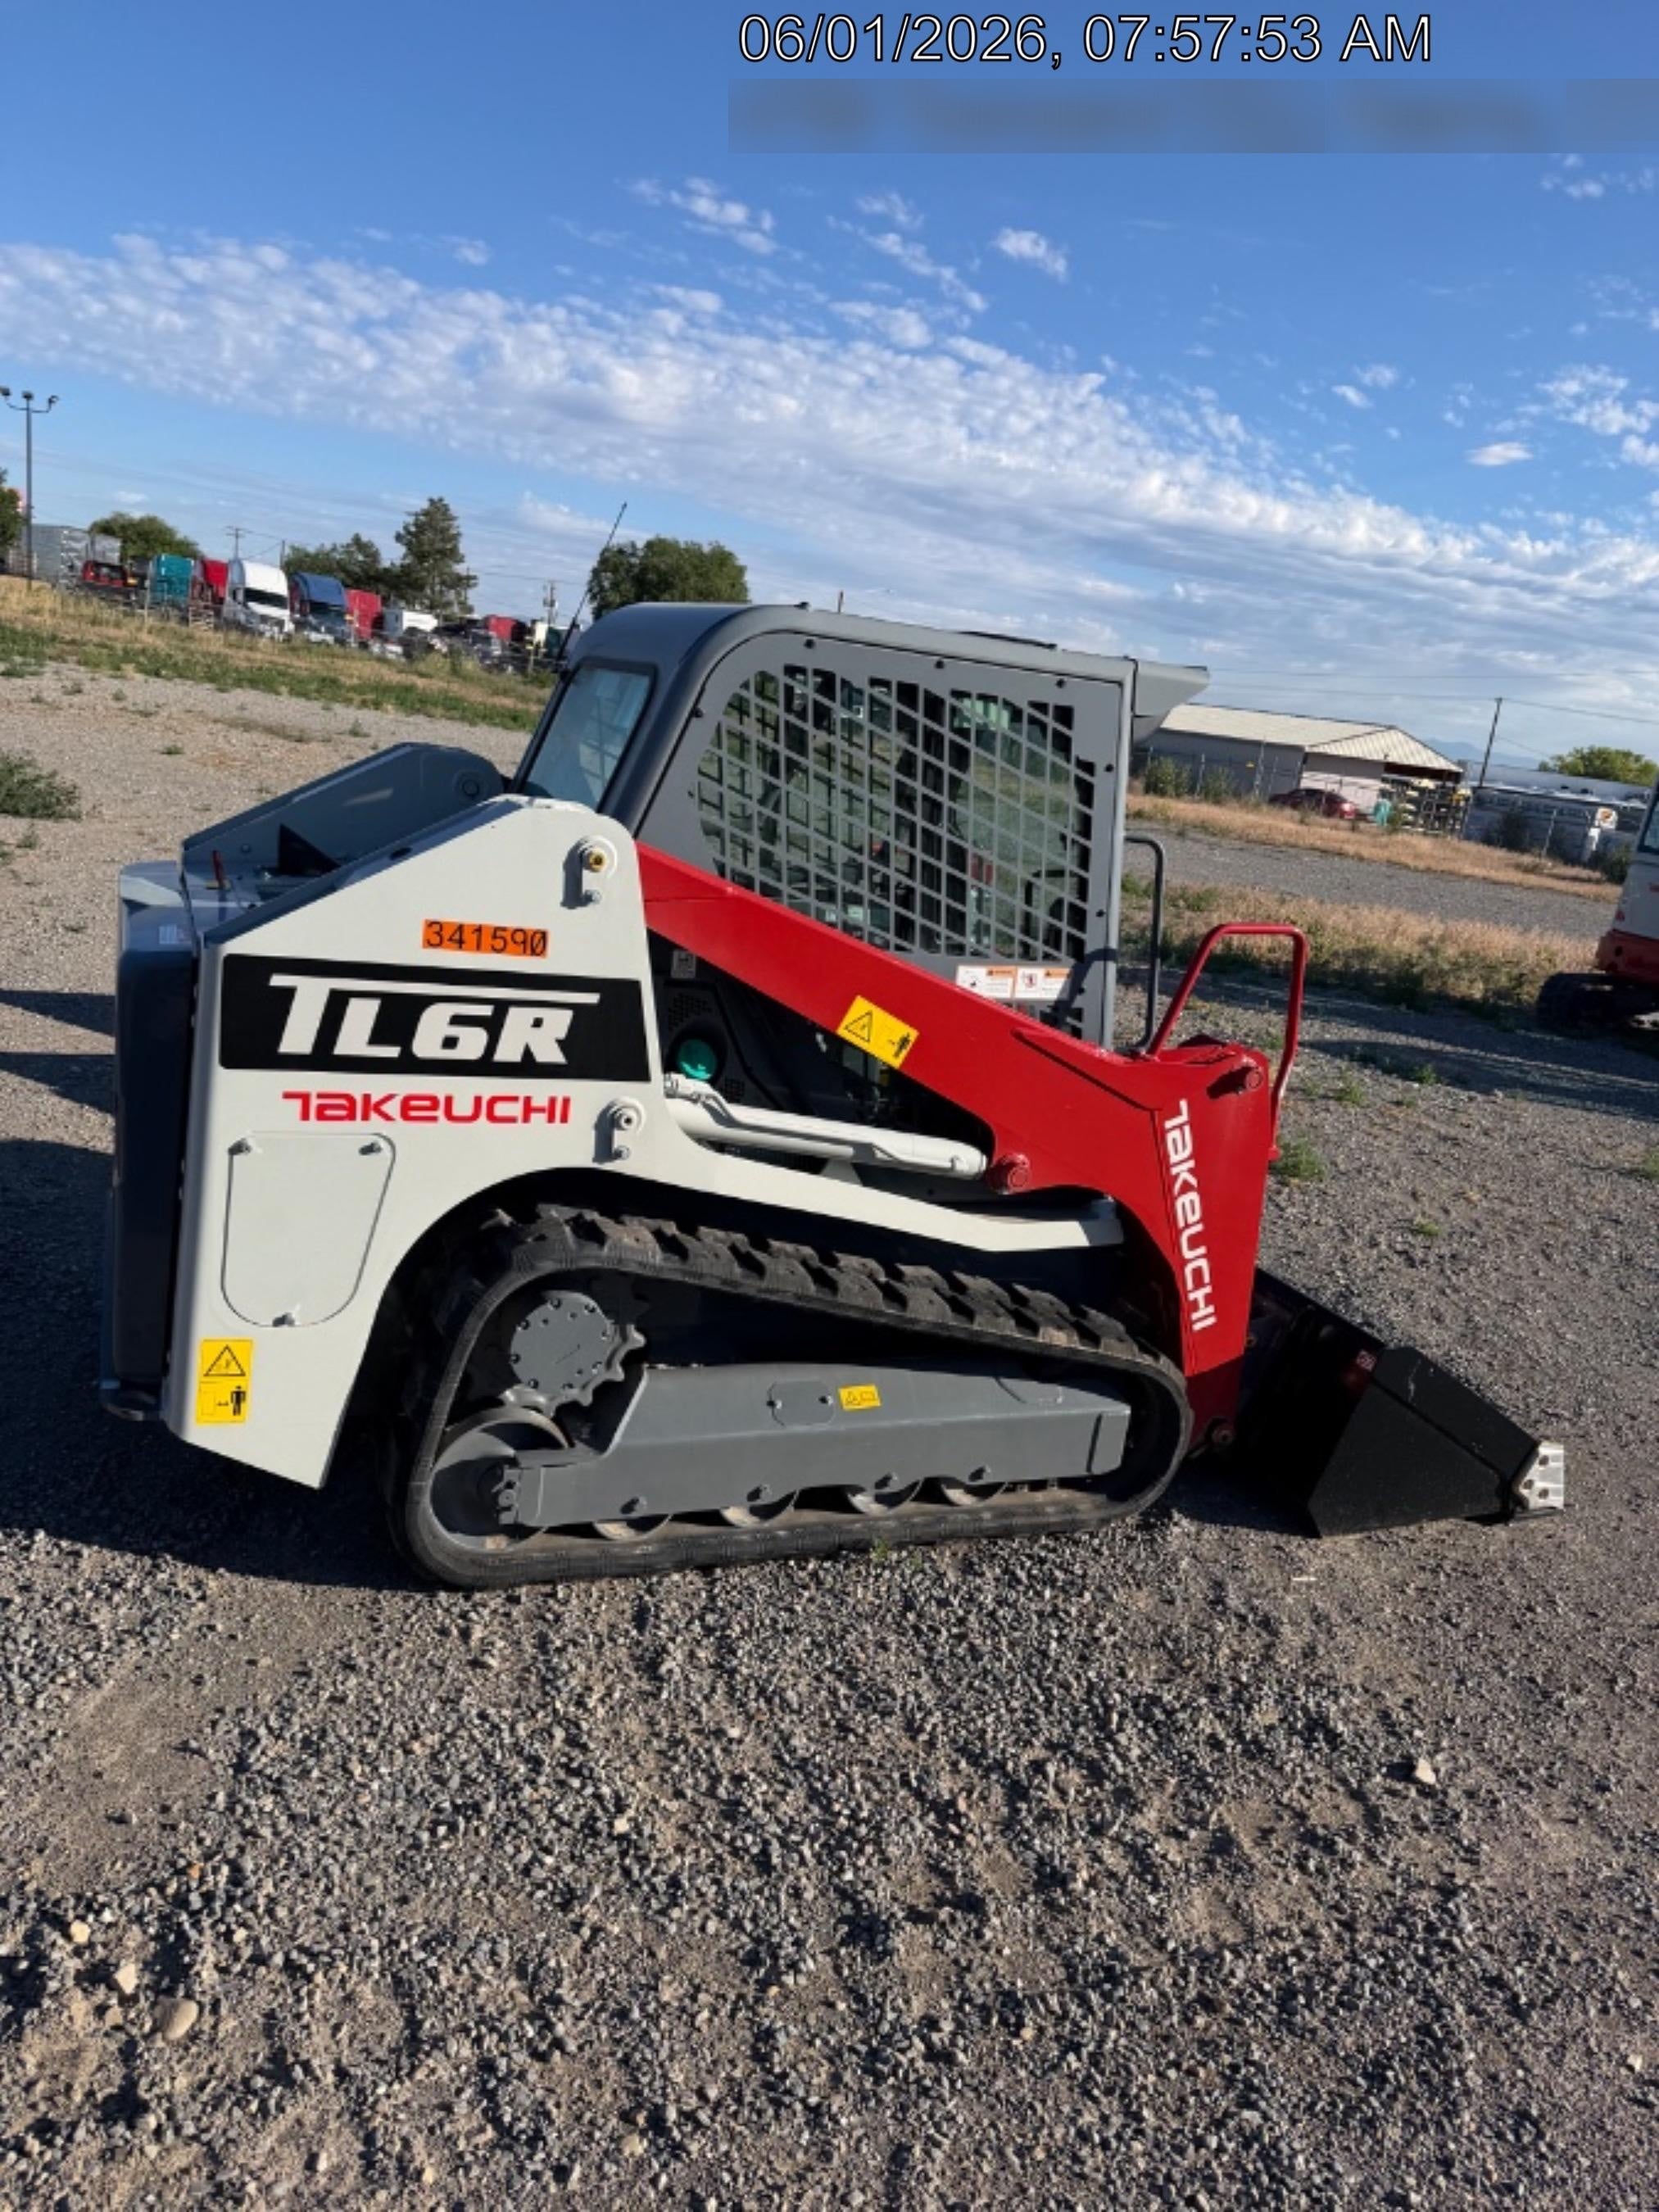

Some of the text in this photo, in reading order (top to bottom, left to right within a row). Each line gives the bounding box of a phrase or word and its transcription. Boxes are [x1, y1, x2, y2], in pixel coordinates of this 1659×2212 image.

[425, 920, 547, 957] 341590
[270, 974, 601, 1065] TL6R
[283, 1091, 571, 1125] TAKEUCHI
